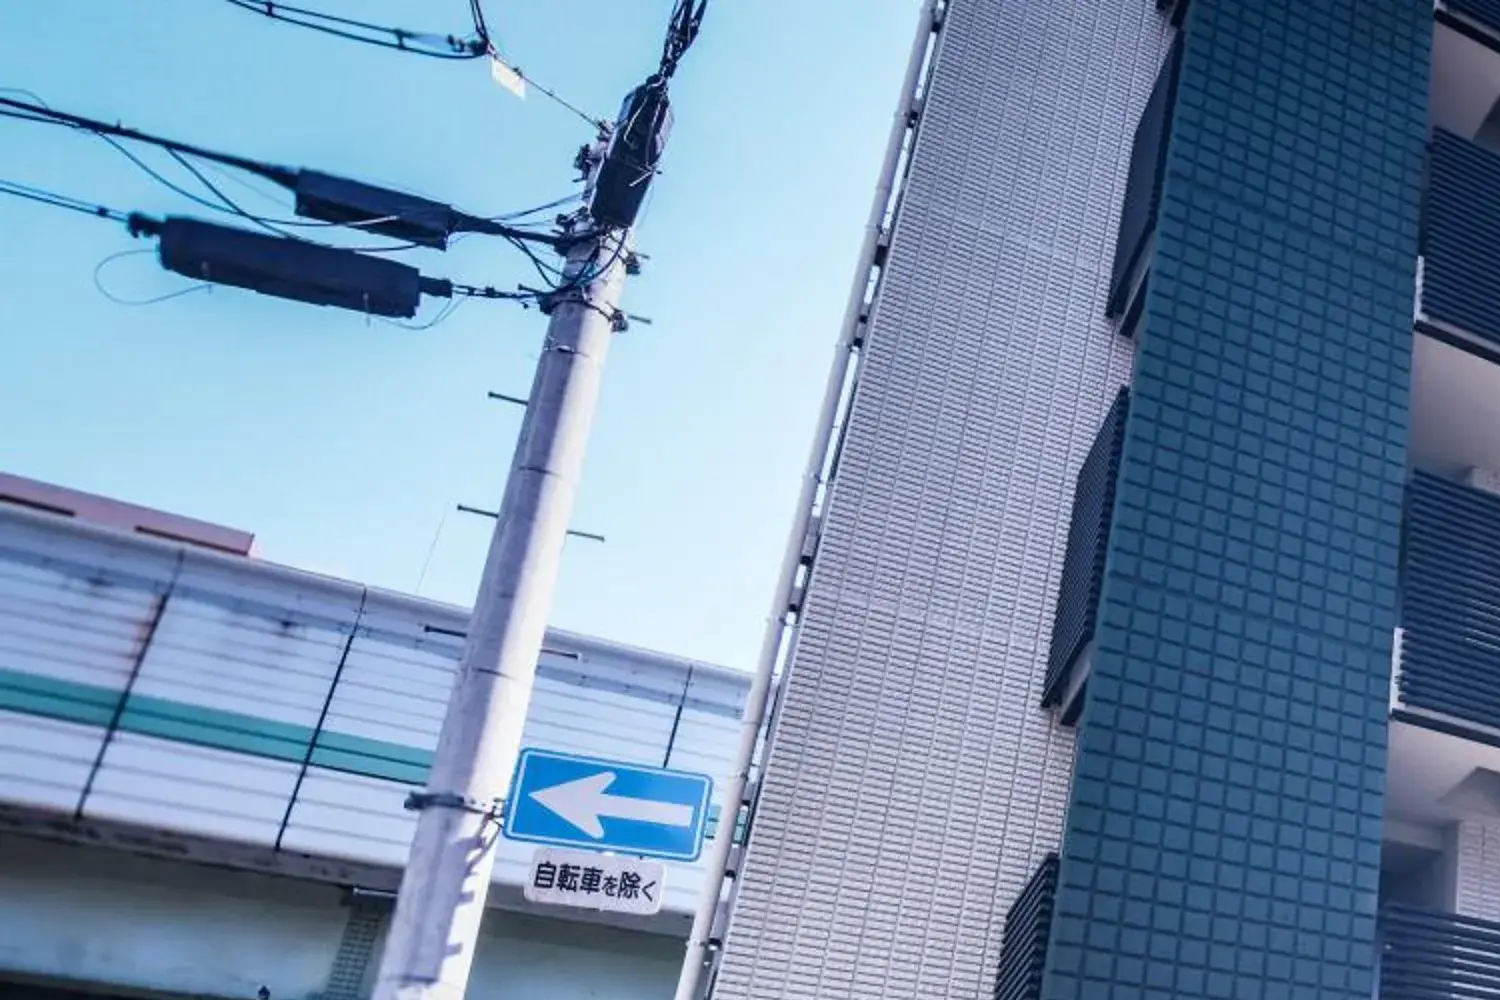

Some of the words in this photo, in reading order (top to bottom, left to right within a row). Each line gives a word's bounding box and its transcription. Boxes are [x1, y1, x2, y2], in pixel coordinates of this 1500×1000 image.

[533, 860, 657, 902] 自転車を除く
